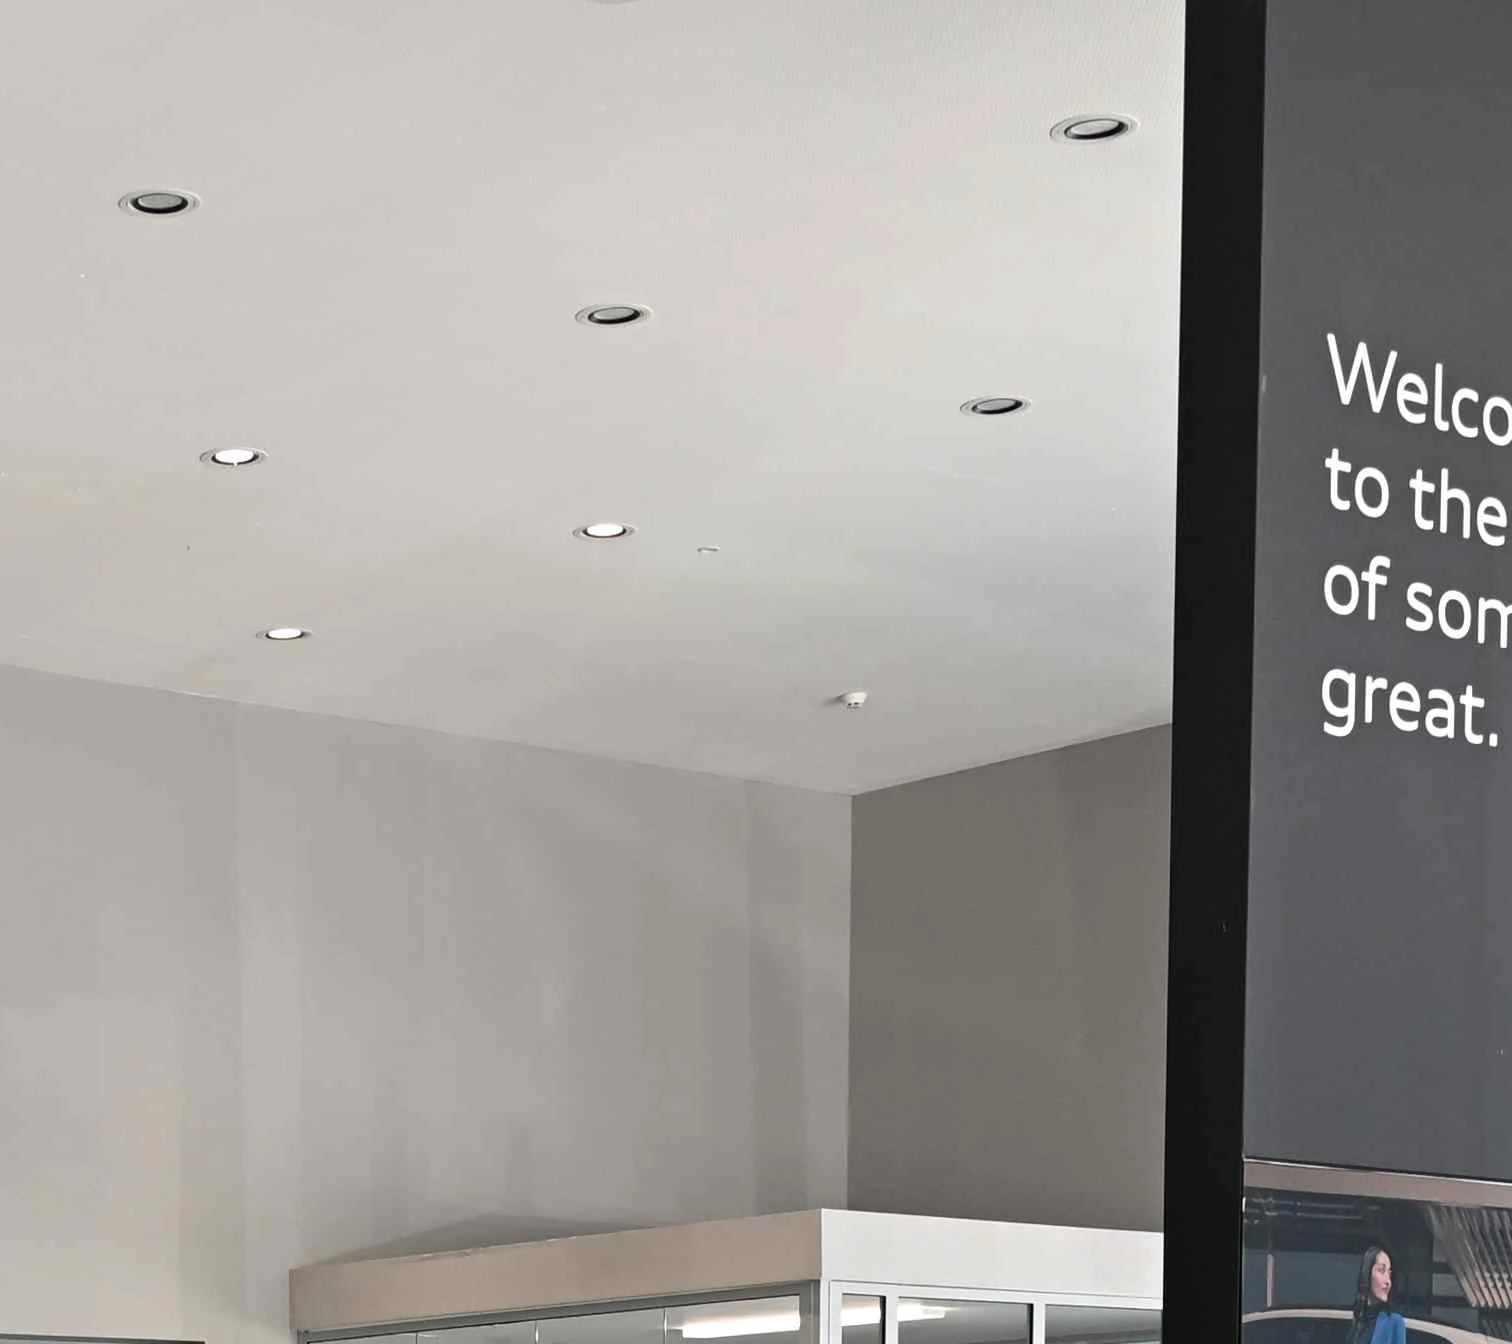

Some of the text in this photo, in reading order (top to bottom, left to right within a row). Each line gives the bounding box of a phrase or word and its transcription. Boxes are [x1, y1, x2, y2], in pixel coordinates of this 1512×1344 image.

[1324, 447, 1390, 518] to
[1409, 467, 1508, 547] the
[1323, 555, 1391, 621] of
[1321, 668, 1499, 748] great.
